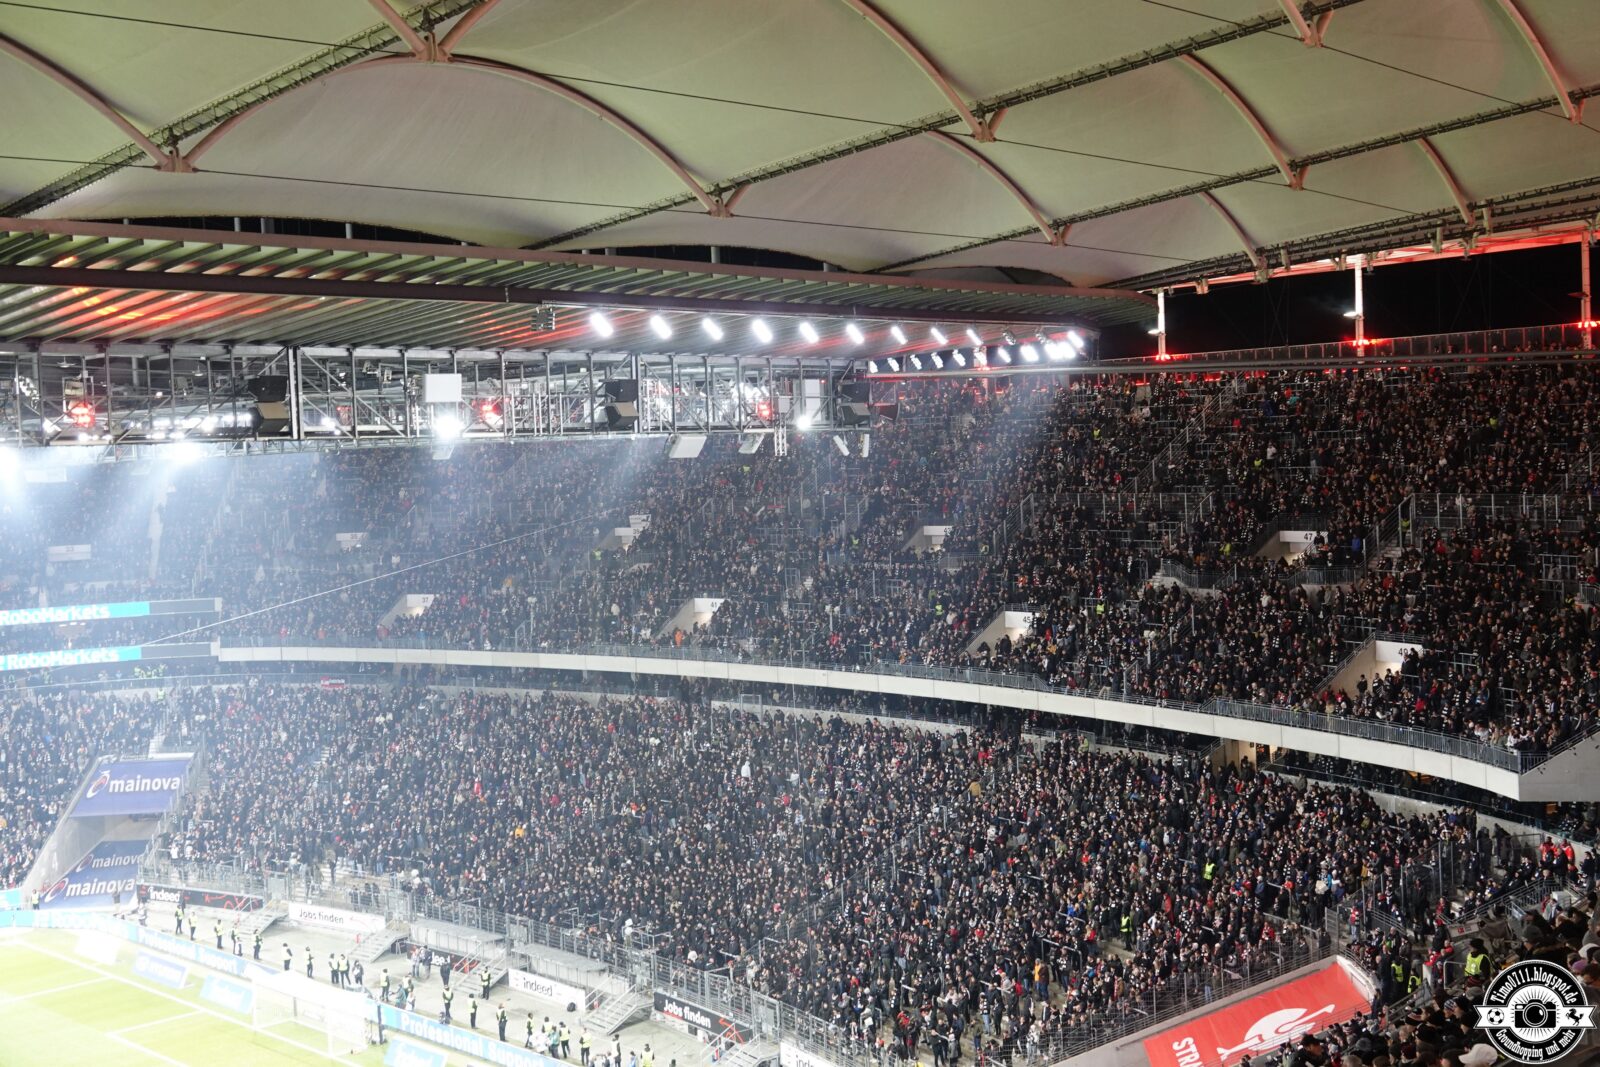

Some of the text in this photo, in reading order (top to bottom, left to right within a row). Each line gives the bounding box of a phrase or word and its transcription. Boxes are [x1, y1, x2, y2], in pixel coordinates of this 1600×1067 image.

[1304, 532, 1313, 541] 47
[1022, 615, 1031, 624] 45
[7, 648, 119, 669] RoboMarkets
[108, 775, 180, 793] mainova
[66, 877, 135, 897] mainova
[148, 886, 180, 902] indeed
[299, 908, 344, 925] Jobs finden
[523, 977, 553, 997] indeed
[664, 999, 711, 1028] Jobs finden
[400, 1012, 483, 1057] Professional
